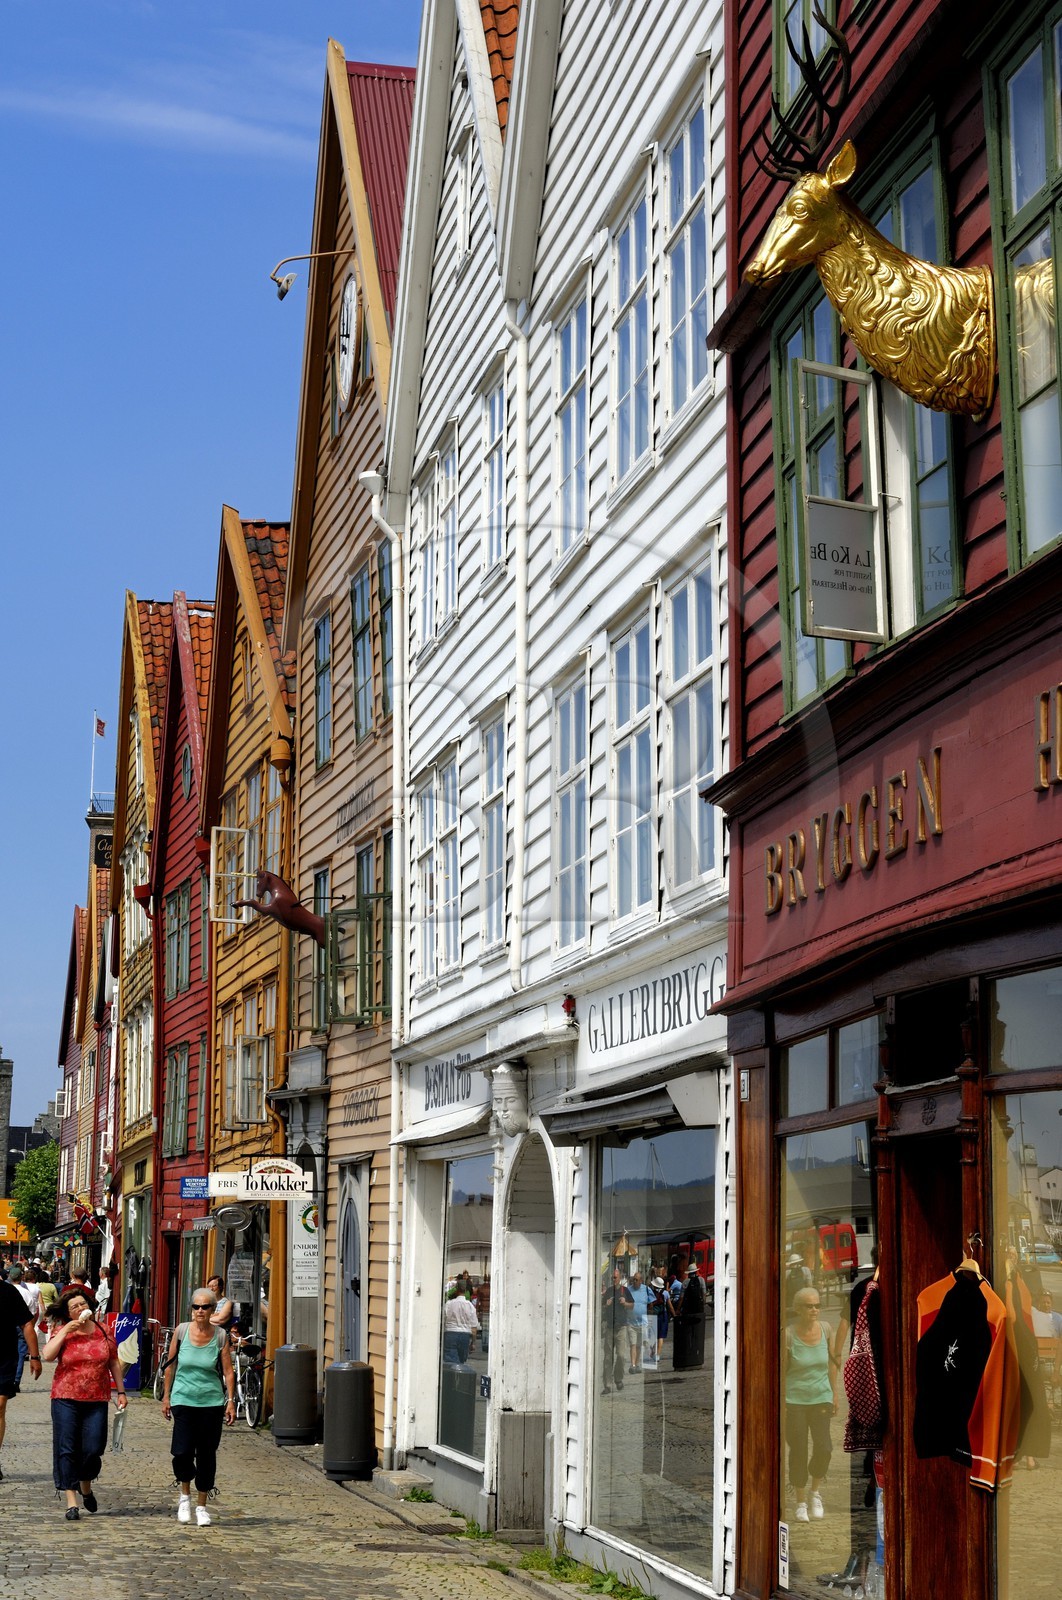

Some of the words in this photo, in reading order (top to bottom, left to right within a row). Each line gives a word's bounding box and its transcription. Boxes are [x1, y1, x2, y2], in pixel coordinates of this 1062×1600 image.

[764, 745, 943, 917] BRYGGEN
[253, 1159, 299, 1172] RESTAURANT
[242, 1174, 258, 1191] To
[260, 1174, 308, 1191] Kokker
